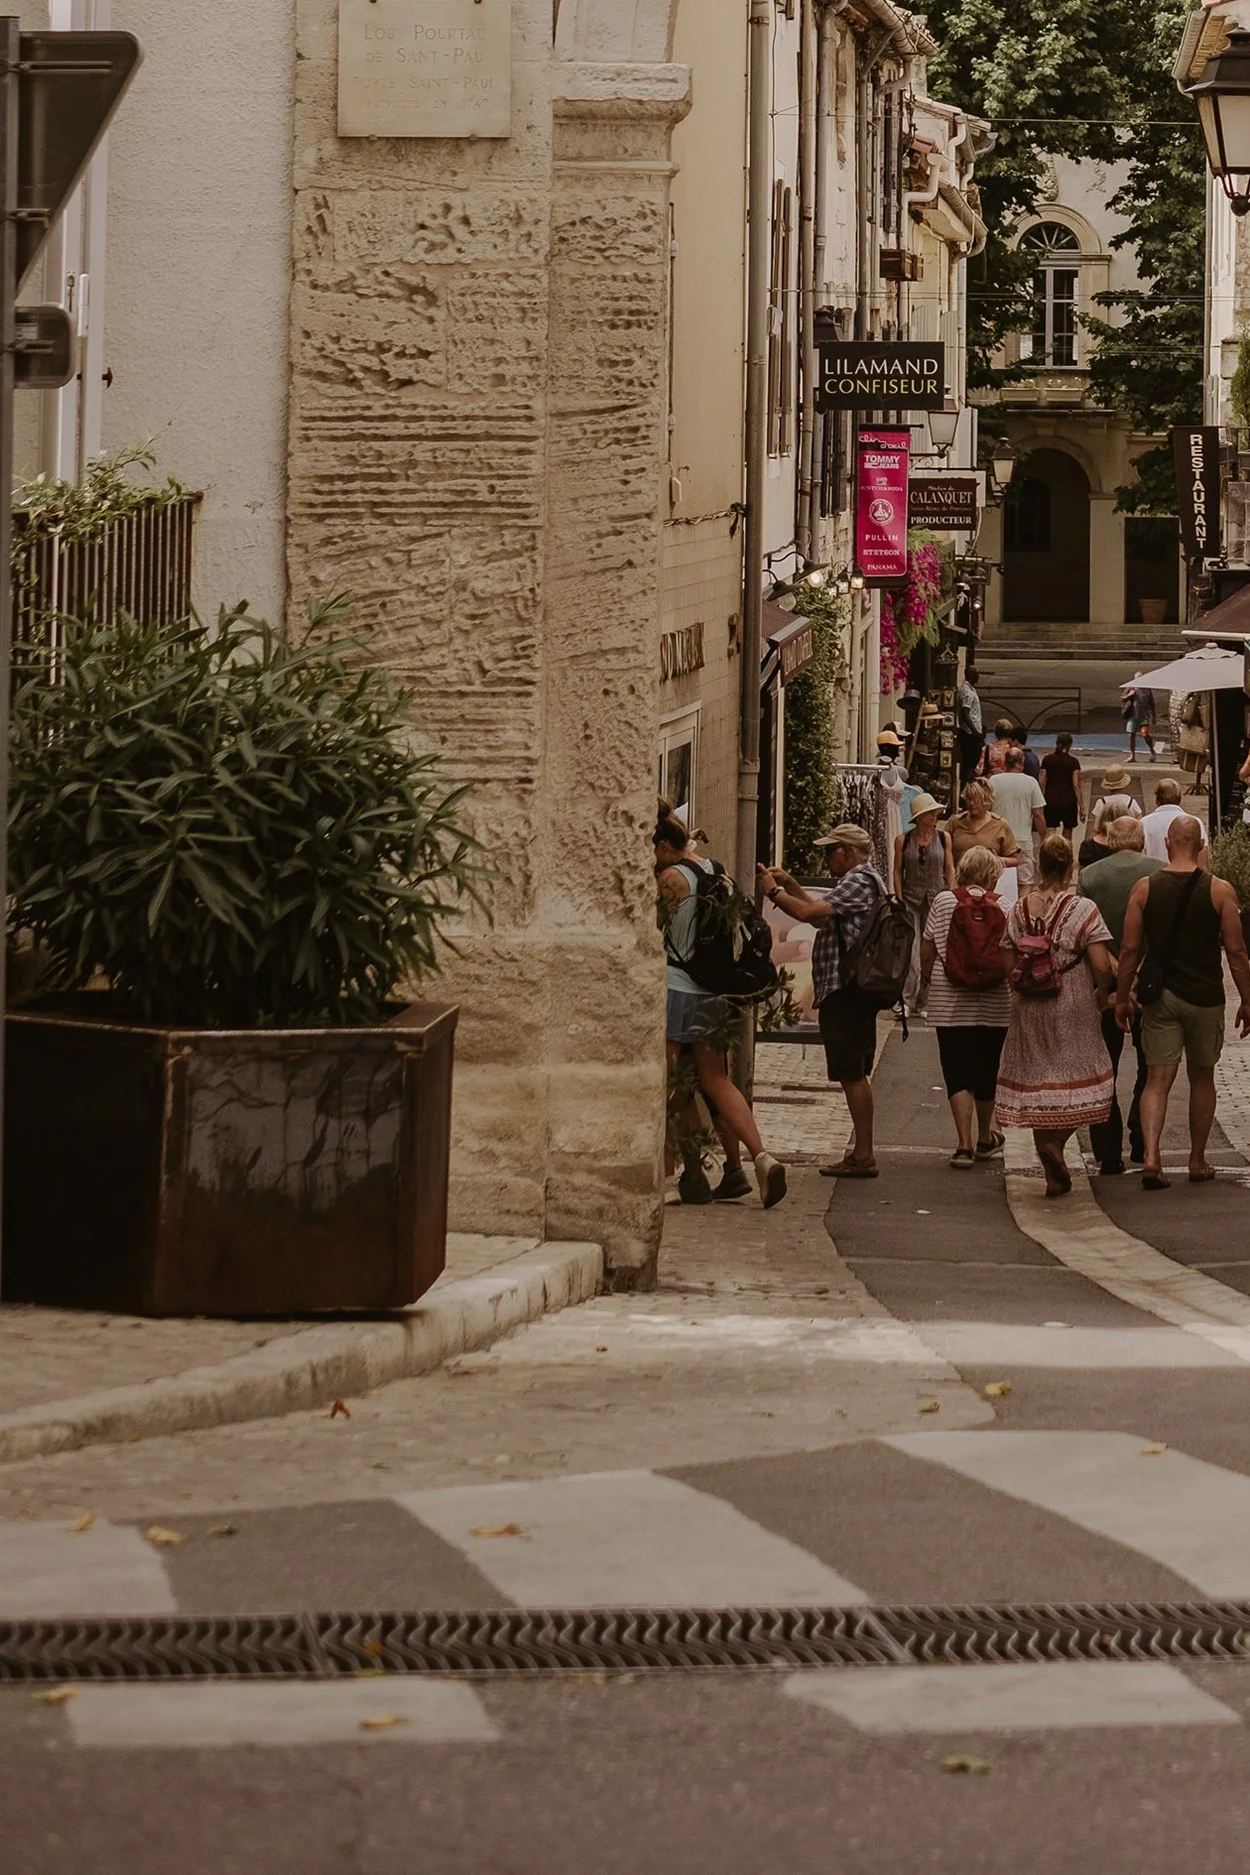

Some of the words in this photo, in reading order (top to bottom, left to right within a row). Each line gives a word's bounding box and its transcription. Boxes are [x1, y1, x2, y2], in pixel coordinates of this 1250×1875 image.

[824, 358, 938, 375] LILAMAND
[824, 378, 938, 395] CONFISEUR
[864, 454, 901, 463] TOMMY
[1189, 434, 1207, 550] RESTAURANT
[910, 491, 973, 505] CALANQUET
[910, 516, 973, 525] PRODUCTEUR
[865, 533, 899, 542] PULLIN
[867, 563, 898, 571] PANAMA
